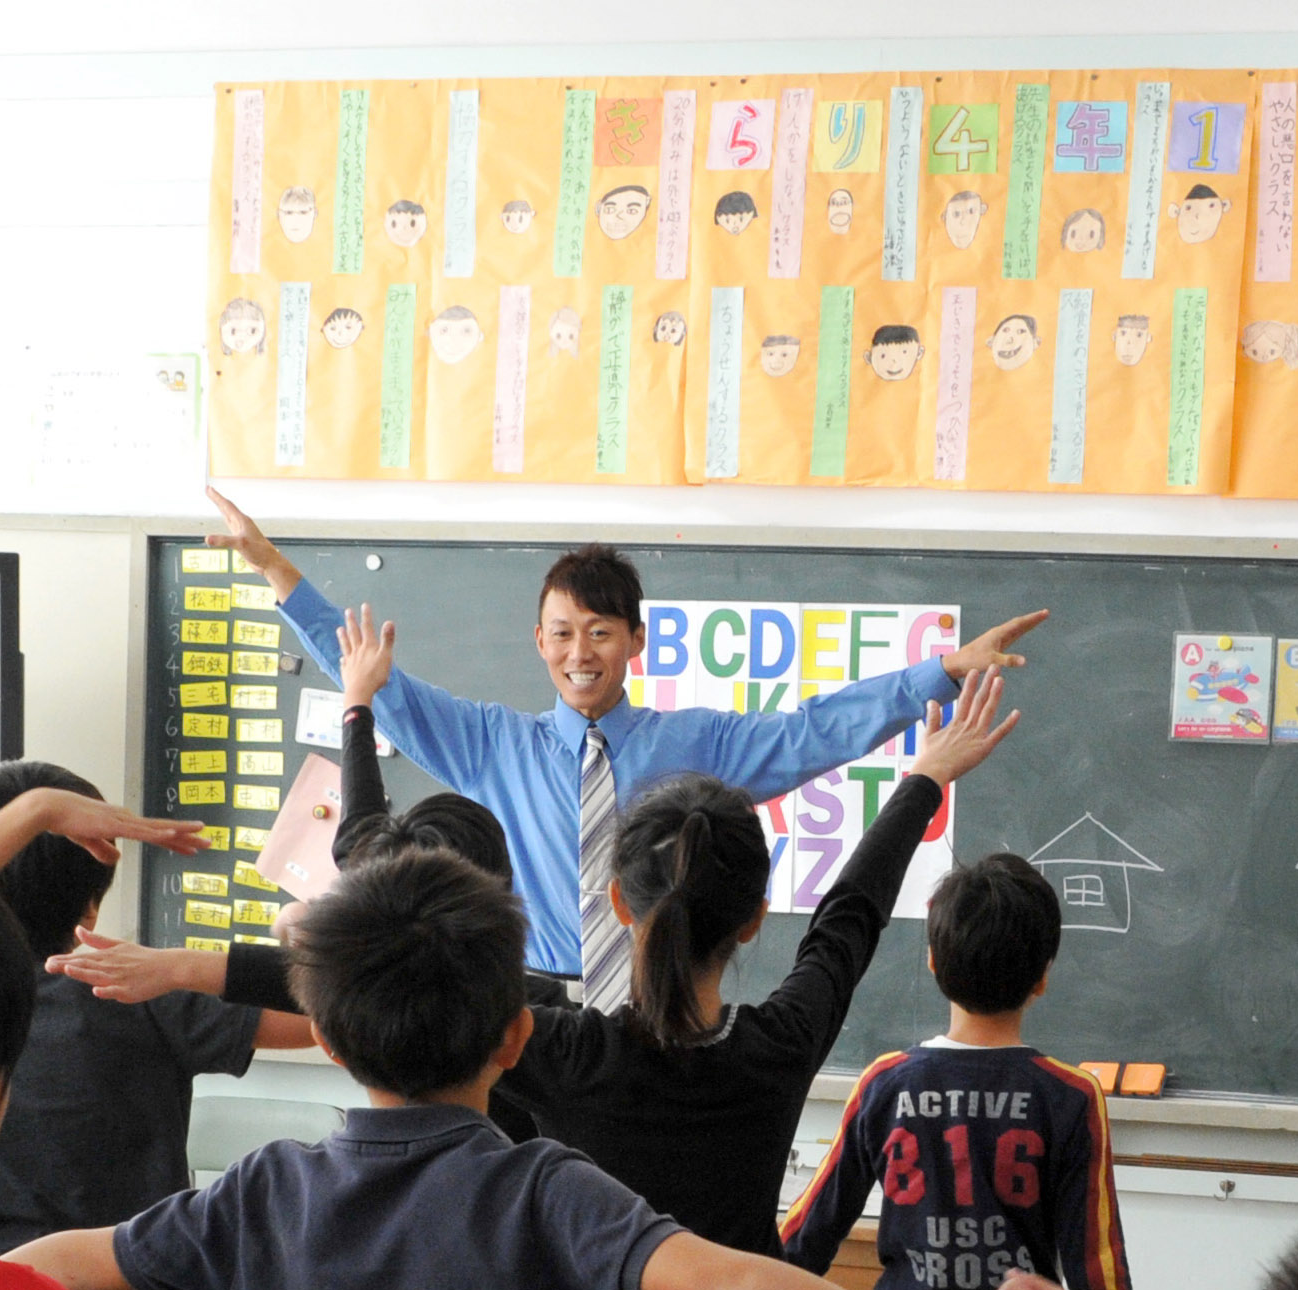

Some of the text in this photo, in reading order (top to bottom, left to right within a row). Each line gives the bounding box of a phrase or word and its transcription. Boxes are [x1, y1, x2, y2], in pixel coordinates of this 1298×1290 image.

[604, 97, 649, 166] き
[725, 101, 762, 168] ら
[828, 102, 866, 170] り
[933, 105, 989, 173] 4
[1055, 102, 1123, 172] 年
[1187, 108, 1223, 171] 1
[1266, 101, 1285, 217] やさしいクラス
[1276, 97, 1296, 253] 人の悪口を言わない
[168, 591, 180, 616] 2
[190, 591, 225, 610] 松村
[169, 624, 181, 646] 3
[165, 654, 180, 678] 4
[169, 686, 180, 708] 5
[165, 715, 179, 737] 6
[187, 754, 221, 771] 井上
[185, 784, 221, 802] 岡本
[895, 1090, 1032, 1120] ACTIVE
[882, 1124, 1046, 1207] 816
[926, 1215, 1007, 1249] USC
[906, 1246, 1033, 1290] CROSS
